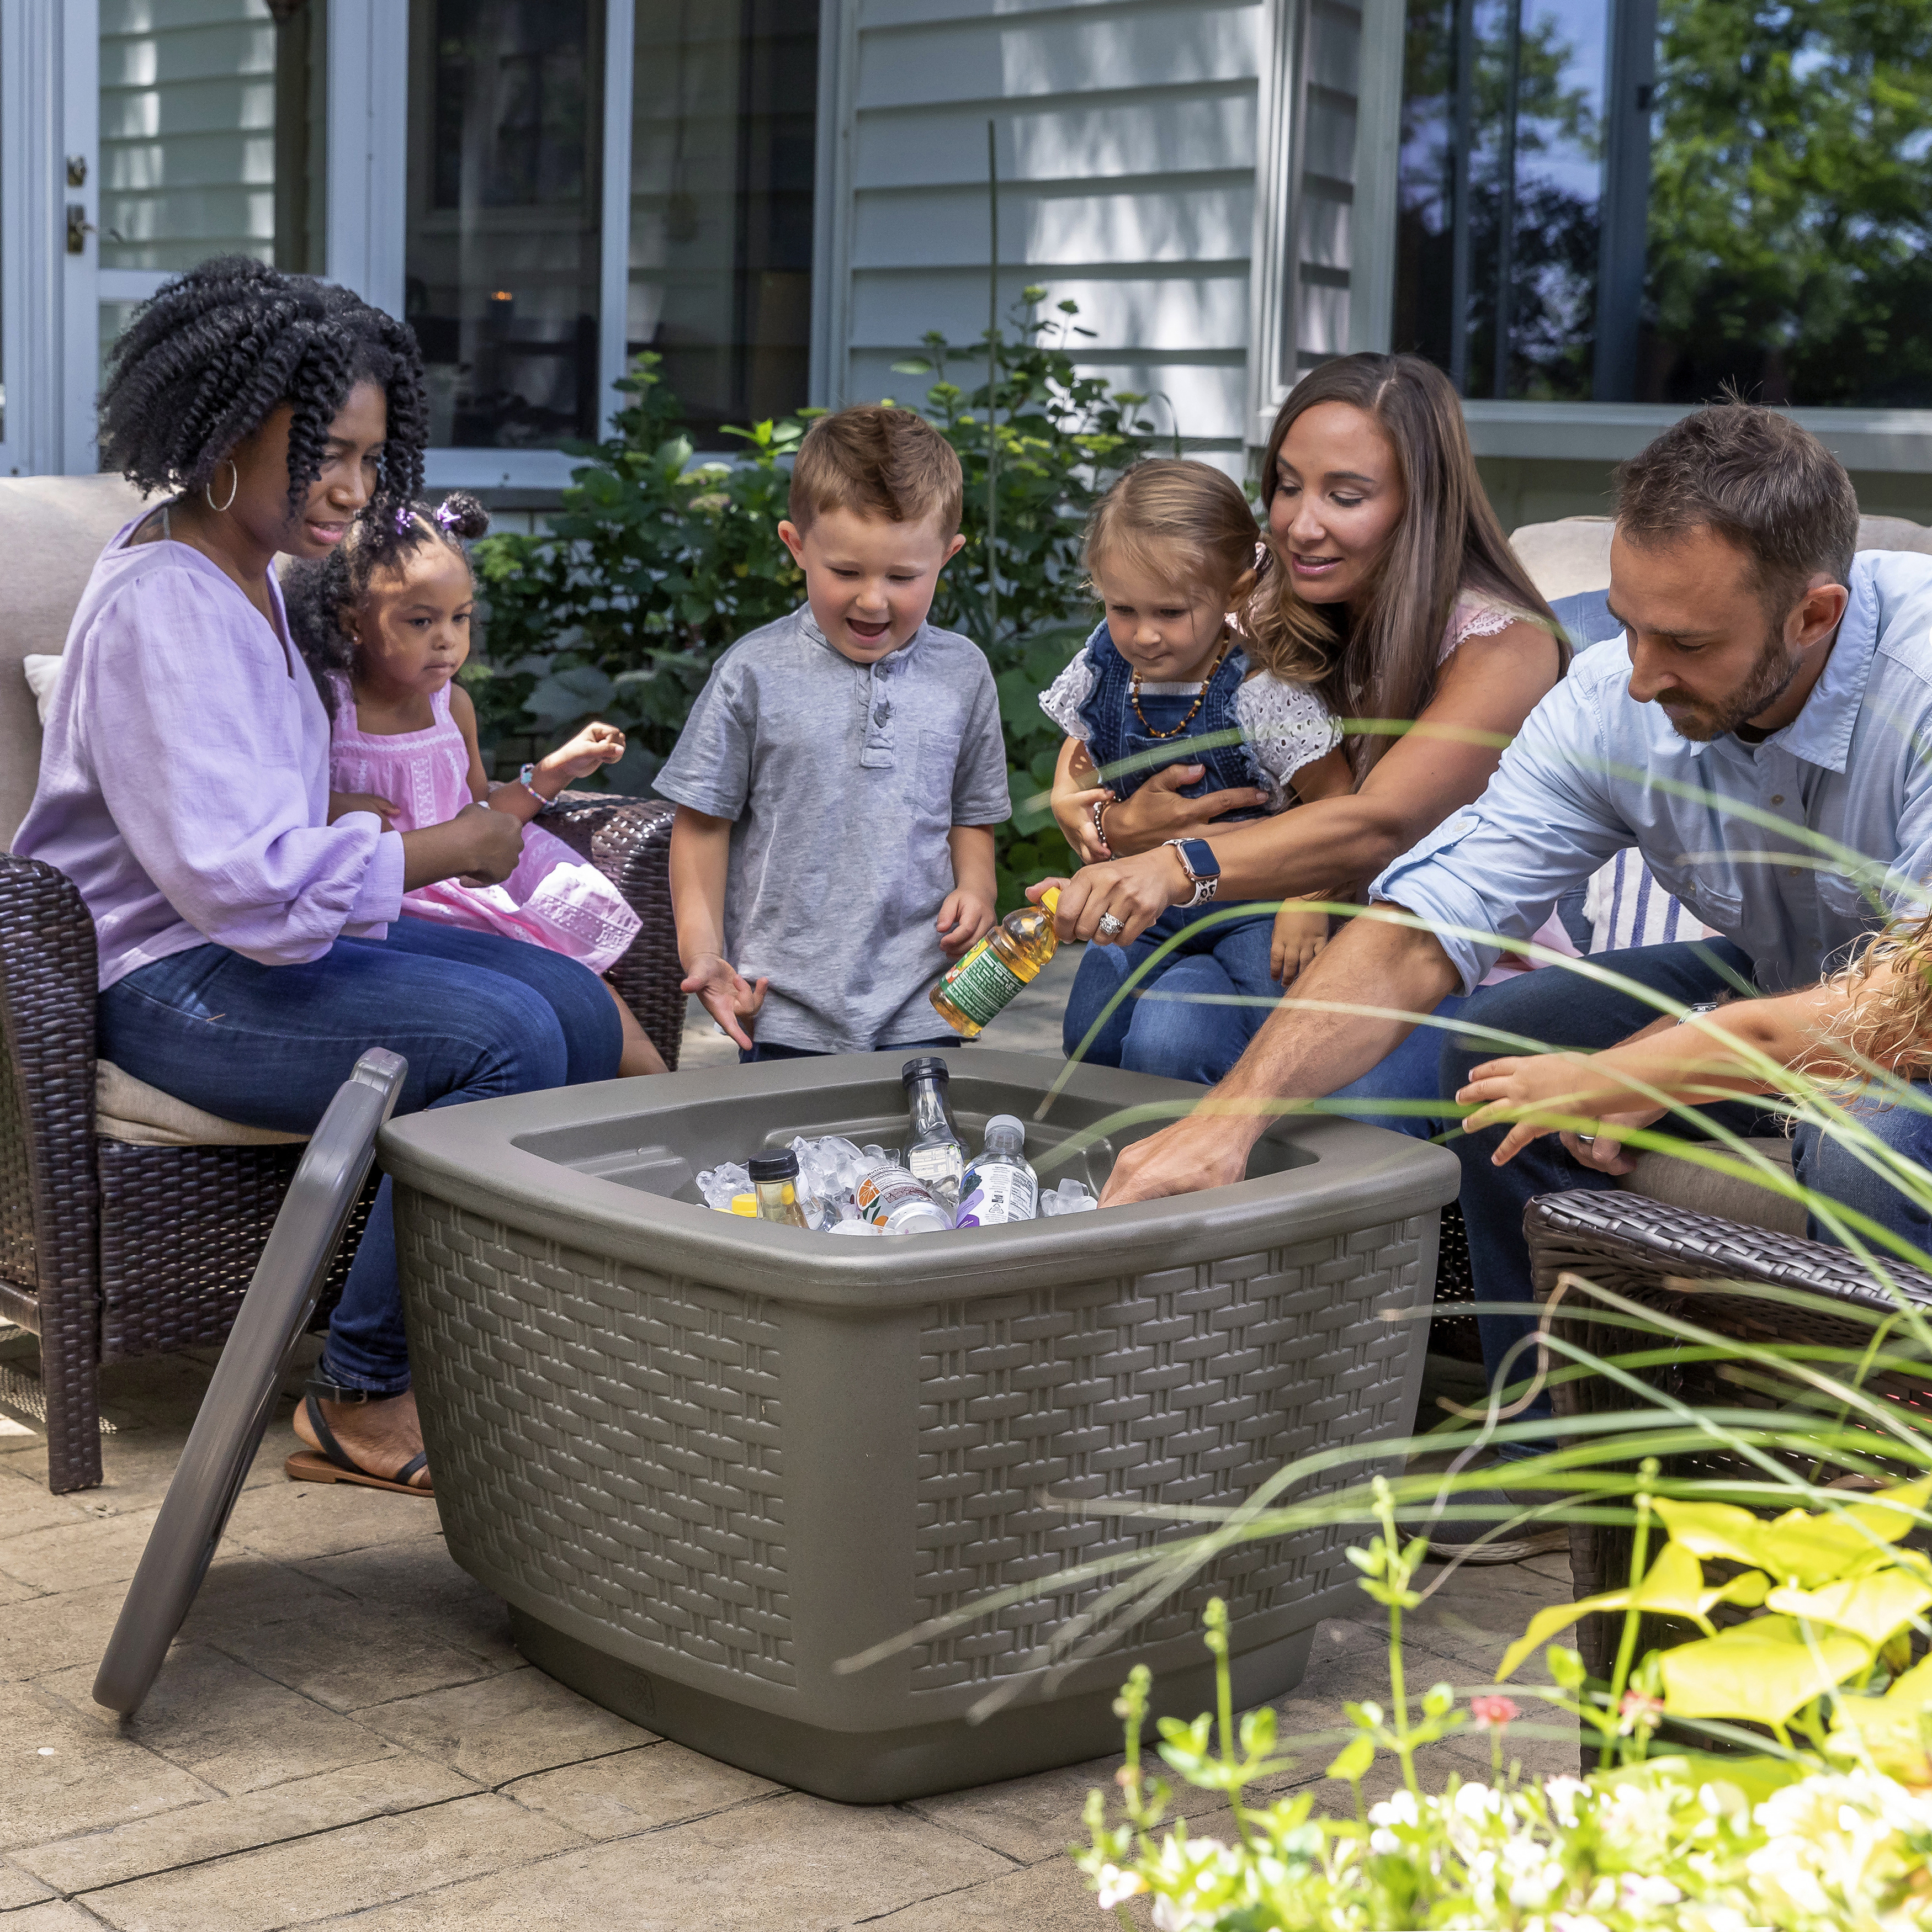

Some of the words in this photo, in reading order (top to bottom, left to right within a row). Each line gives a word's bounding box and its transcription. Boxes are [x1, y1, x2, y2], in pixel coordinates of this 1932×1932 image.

[994, 967, 1002, 976] Facts
[867, 1166, 893, 1176] Nutrition
[872, 1173, 893, 1182] Calories
[1013, 1172, 1027, 1183] Nutrition
